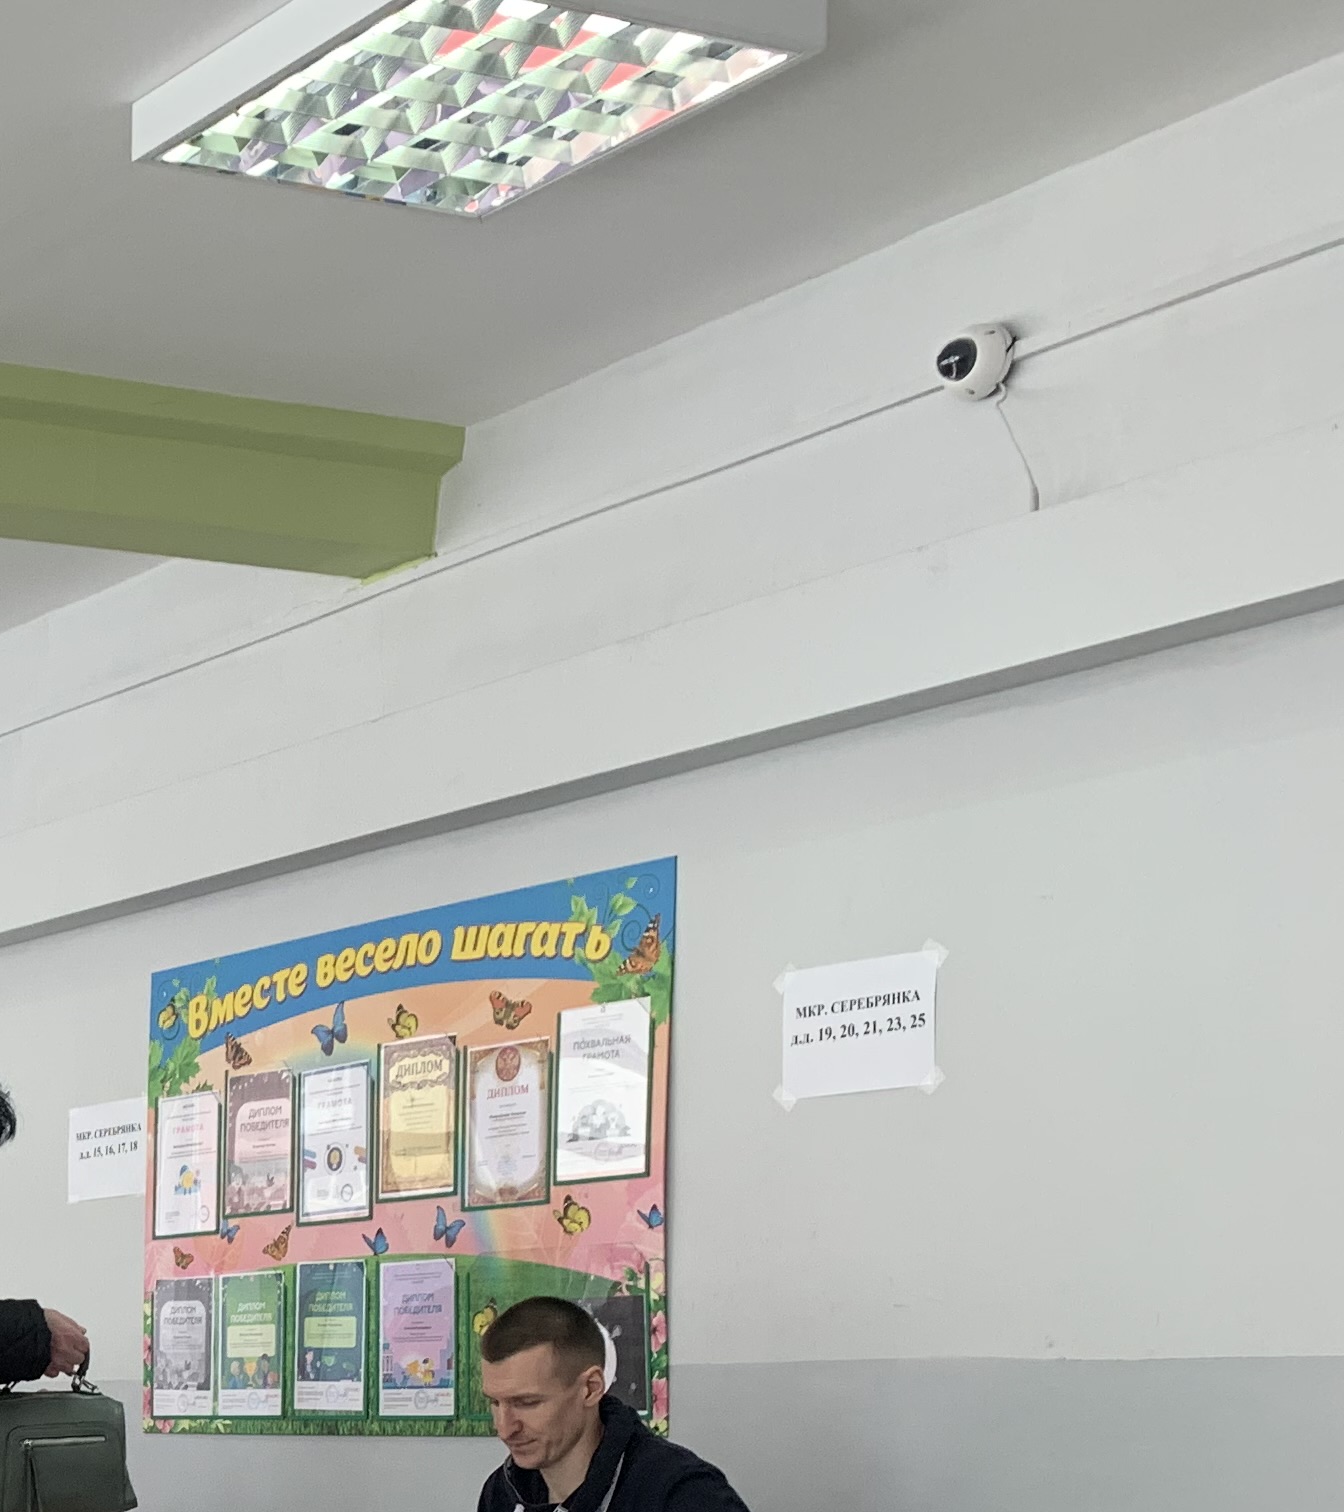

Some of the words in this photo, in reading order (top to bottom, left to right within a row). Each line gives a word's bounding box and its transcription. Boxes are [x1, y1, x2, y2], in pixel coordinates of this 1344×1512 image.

[187, 962, 308, 1038] Вместе
[316, 929, 442, 988] весело
[451, 921, 611, 962] шагать
[796, 1004, 827, 1019] МКР.
[831, 990, 920, 1014] СЕРЕБРЯНКА
[819, 1026, 836, 1042] 19,
[840, 1023, 859, 1039] 20,
[863, 1020, 883, 1036] 21,
[887, 1016, 906, 1032] 23,
[910, 1013, 926, 1029] 25
[573, 1034, 631, 1050] ПОХВАЛЬНАЯ
[395, 1059, 443, 1079] ДИПЛОМ
[487, 1084, 529, 1099] ДИПЛОМ
[248, 1105, 283, 1119] ДИПЛОМ
[94, 1123, 141, 1138] СЕРЕБРЯНКА
[240, 1118, 289, 1133] ПОБЕДИТЕЛЯ
[237, 1302, 266, 1312] ДИПЛОМ
